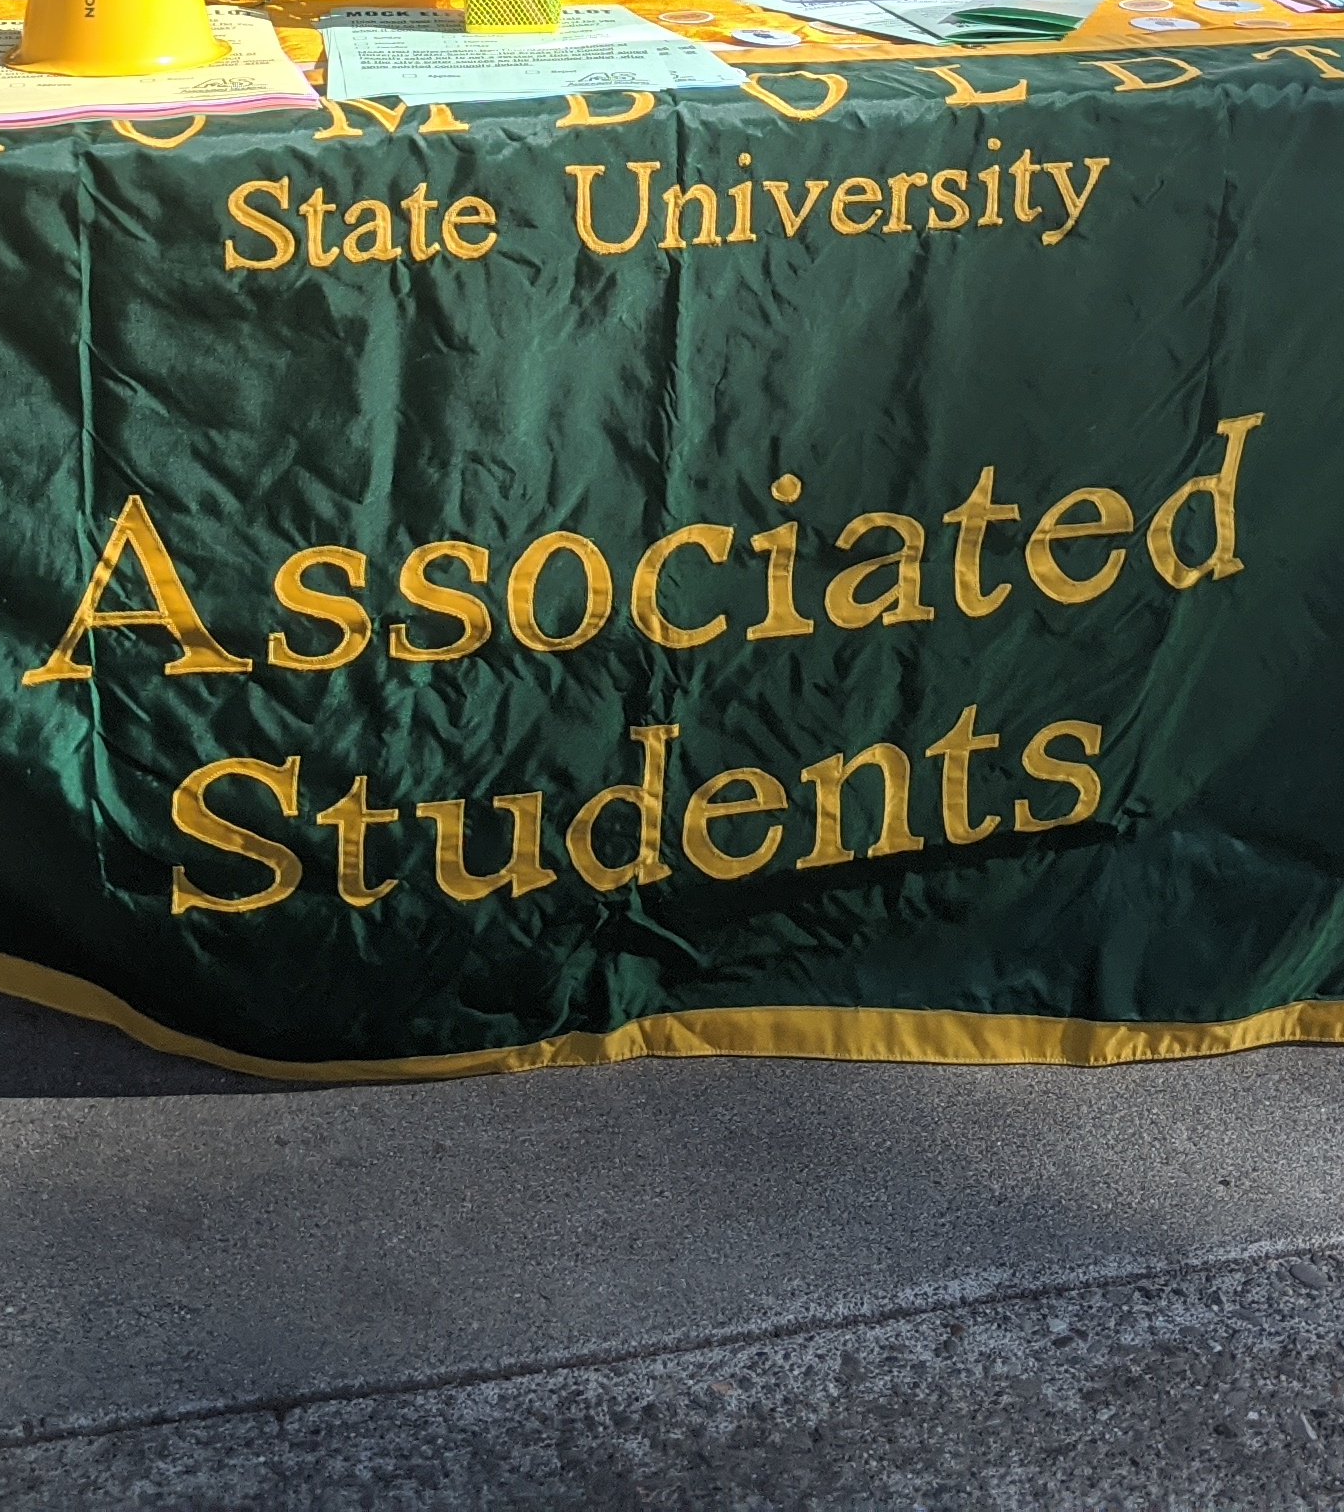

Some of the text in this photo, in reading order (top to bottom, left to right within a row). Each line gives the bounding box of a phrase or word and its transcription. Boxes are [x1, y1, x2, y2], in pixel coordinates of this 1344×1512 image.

[346, 10, 409, 18] MOCK
[225, 137, 1111, 272] State University
[21, 411, 1265, 688] Associated
[170, 703, 1104, 917] Students
